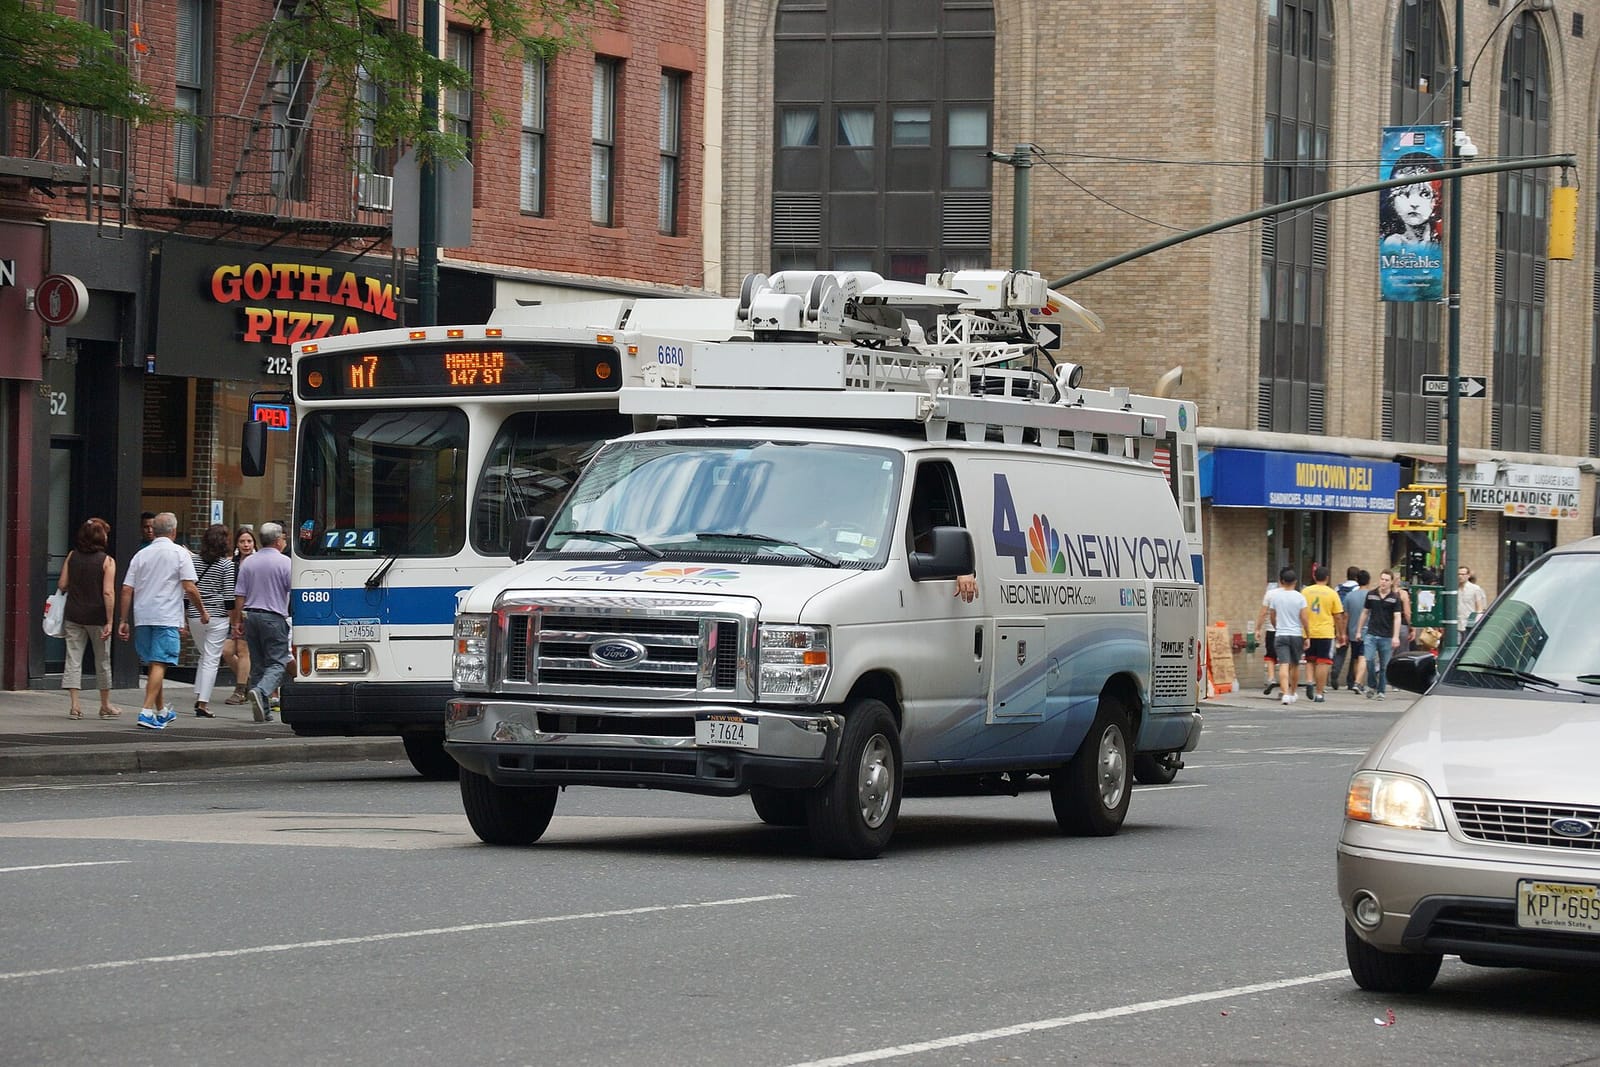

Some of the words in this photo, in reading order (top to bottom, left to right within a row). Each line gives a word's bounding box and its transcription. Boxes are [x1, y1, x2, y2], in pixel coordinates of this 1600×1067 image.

[210, 262, 399, 321] GOTHAM
[445, 351, 504, 369] HARLEM
[658, 344, 684, 367] 6680
[351, 355, 378, 388] M7
[450, 369, 478, 385] 147
[483, 368, 503, 384] ST
[1428, 382, 1447, 391] ONE
[256, 407, 288, 427] OPEN
[1296, 462, 1347, 490] MIDTOWN
[1349, 467, 1372, 491] DELI
[1470, 488, 1552, 506] MERCHANDISE
[1557, 493, 1578, 508] INC.
[213, 503, 222, 521] A
[992, 473, 1028, 574] 4
[1063, 533, 1120, 578] NEW
[1122, 536, 1187, 580] YORK
[563, 560, 659, 576] 4
[545, 575, 620, 583] NEW
[634, 576, 728, 588] YORK
[301, 591, 330, 602] 6680
[602, 646, 629, 658] Ford
[719, 723, 744, 741] 7624
[1541, 918, 1566, 927] Garden
[1567, 920, 1586, 928] State
